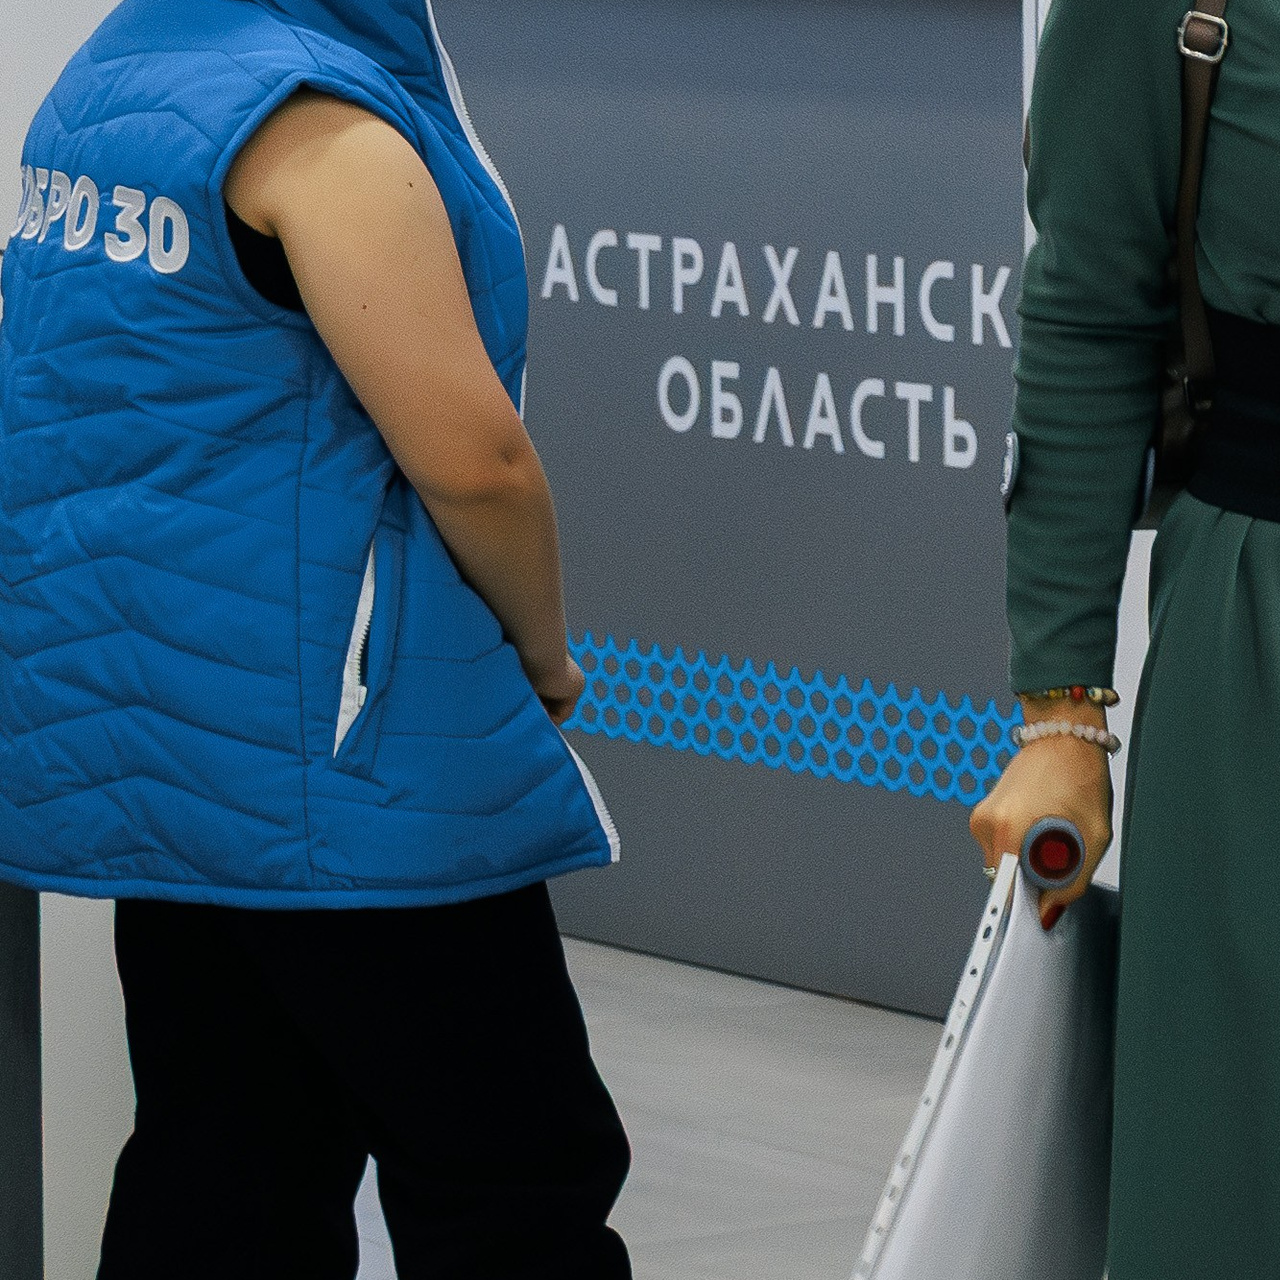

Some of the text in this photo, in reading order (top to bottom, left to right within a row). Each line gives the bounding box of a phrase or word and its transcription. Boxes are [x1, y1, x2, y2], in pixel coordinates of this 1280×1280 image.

[104, 185, 190, 274] 30
[540, 223, 1013, 348] АСТРАХАНСК
[657, 355, 979, 469] ОБЛАСТЬ
